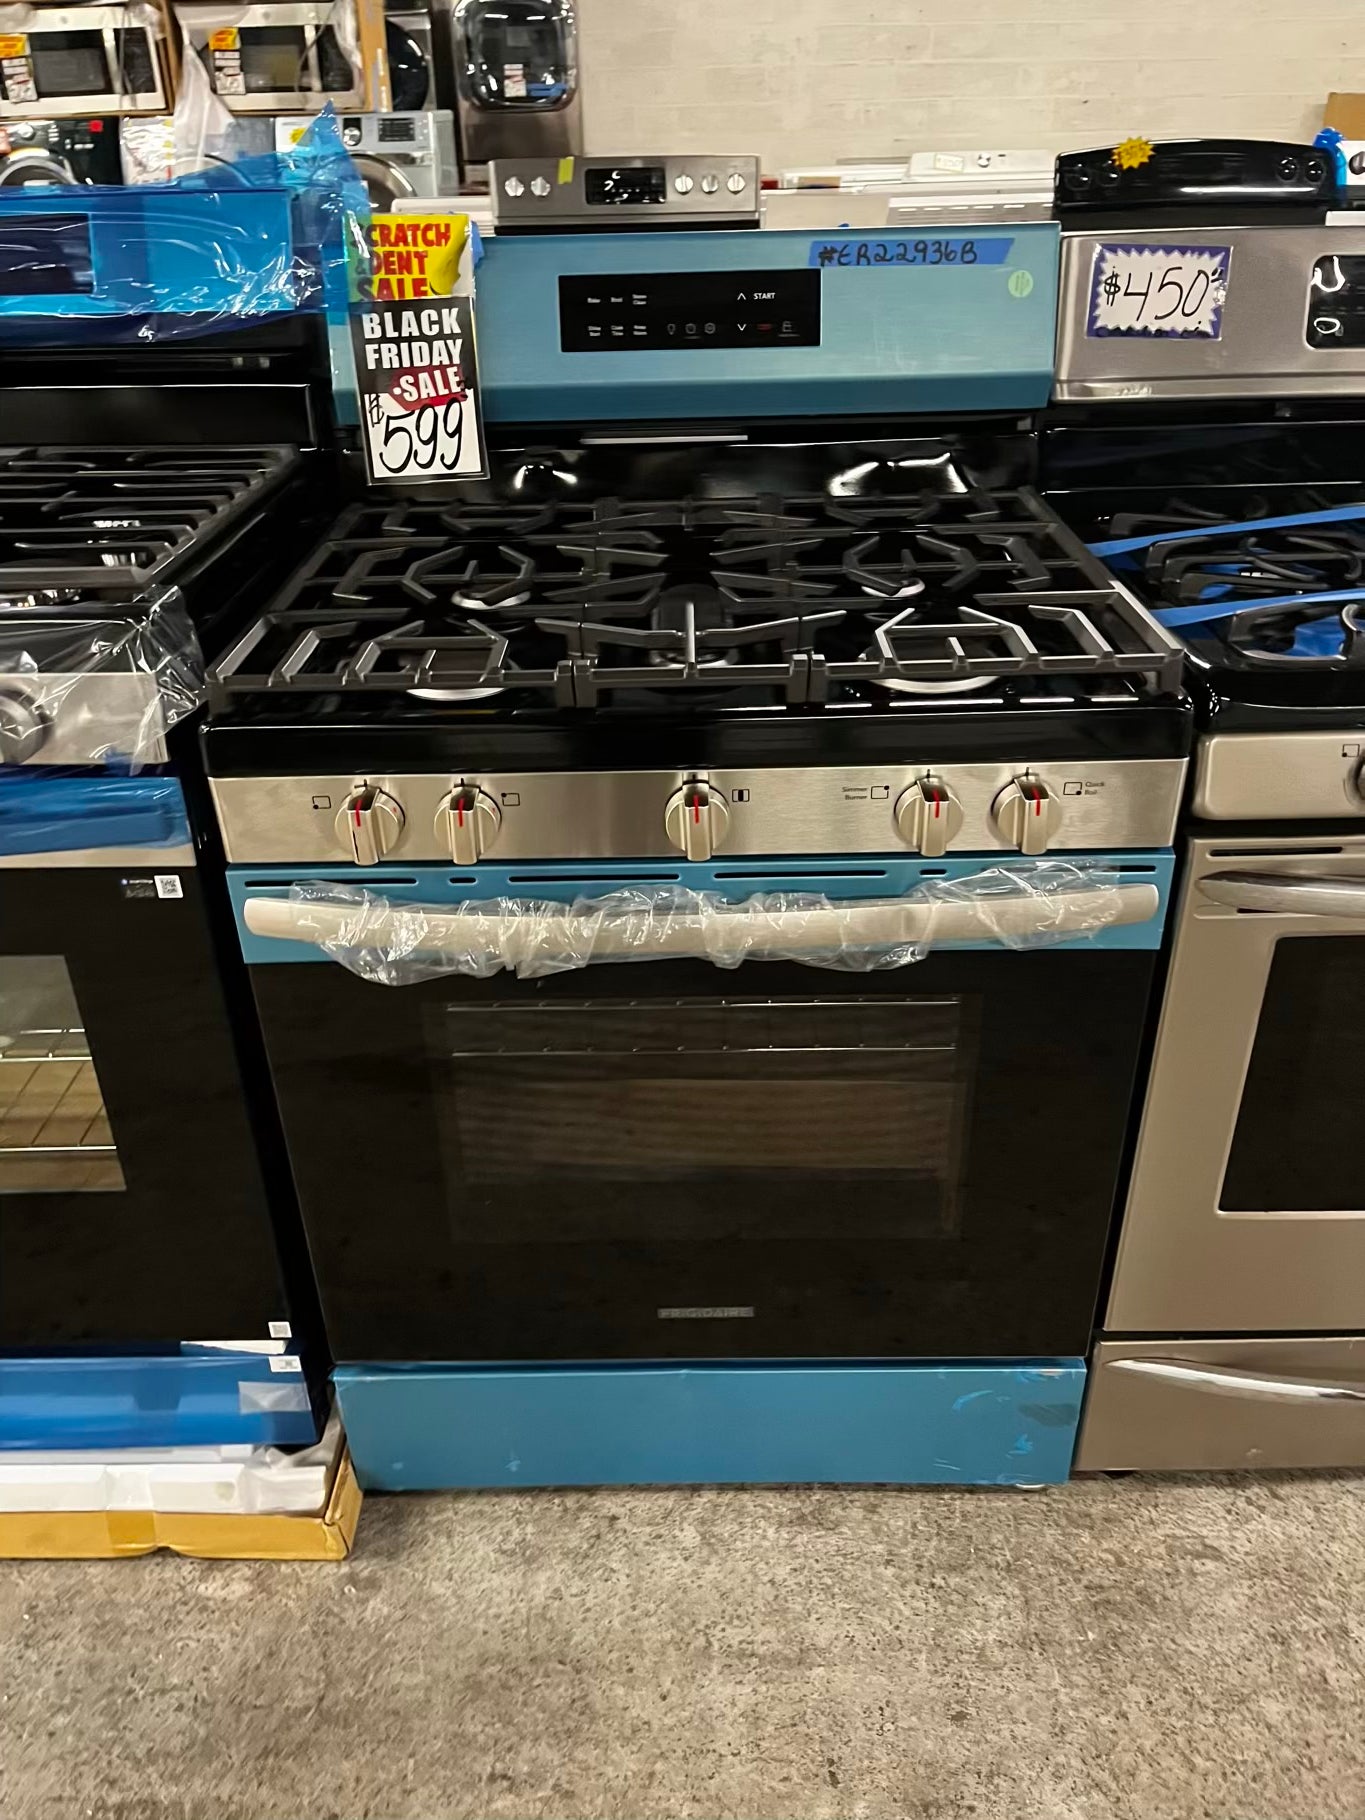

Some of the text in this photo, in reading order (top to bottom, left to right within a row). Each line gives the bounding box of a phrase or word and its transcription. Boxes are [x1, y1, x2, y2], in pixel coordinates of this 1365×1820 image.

[368, 250, 429, 276] DENT
[753, 292, 776, 300] START
[362, 307, 462, 339] BLACK
[364, 339, 463, 370] FRIDAY
[399, 366, 462, 402] SALE
